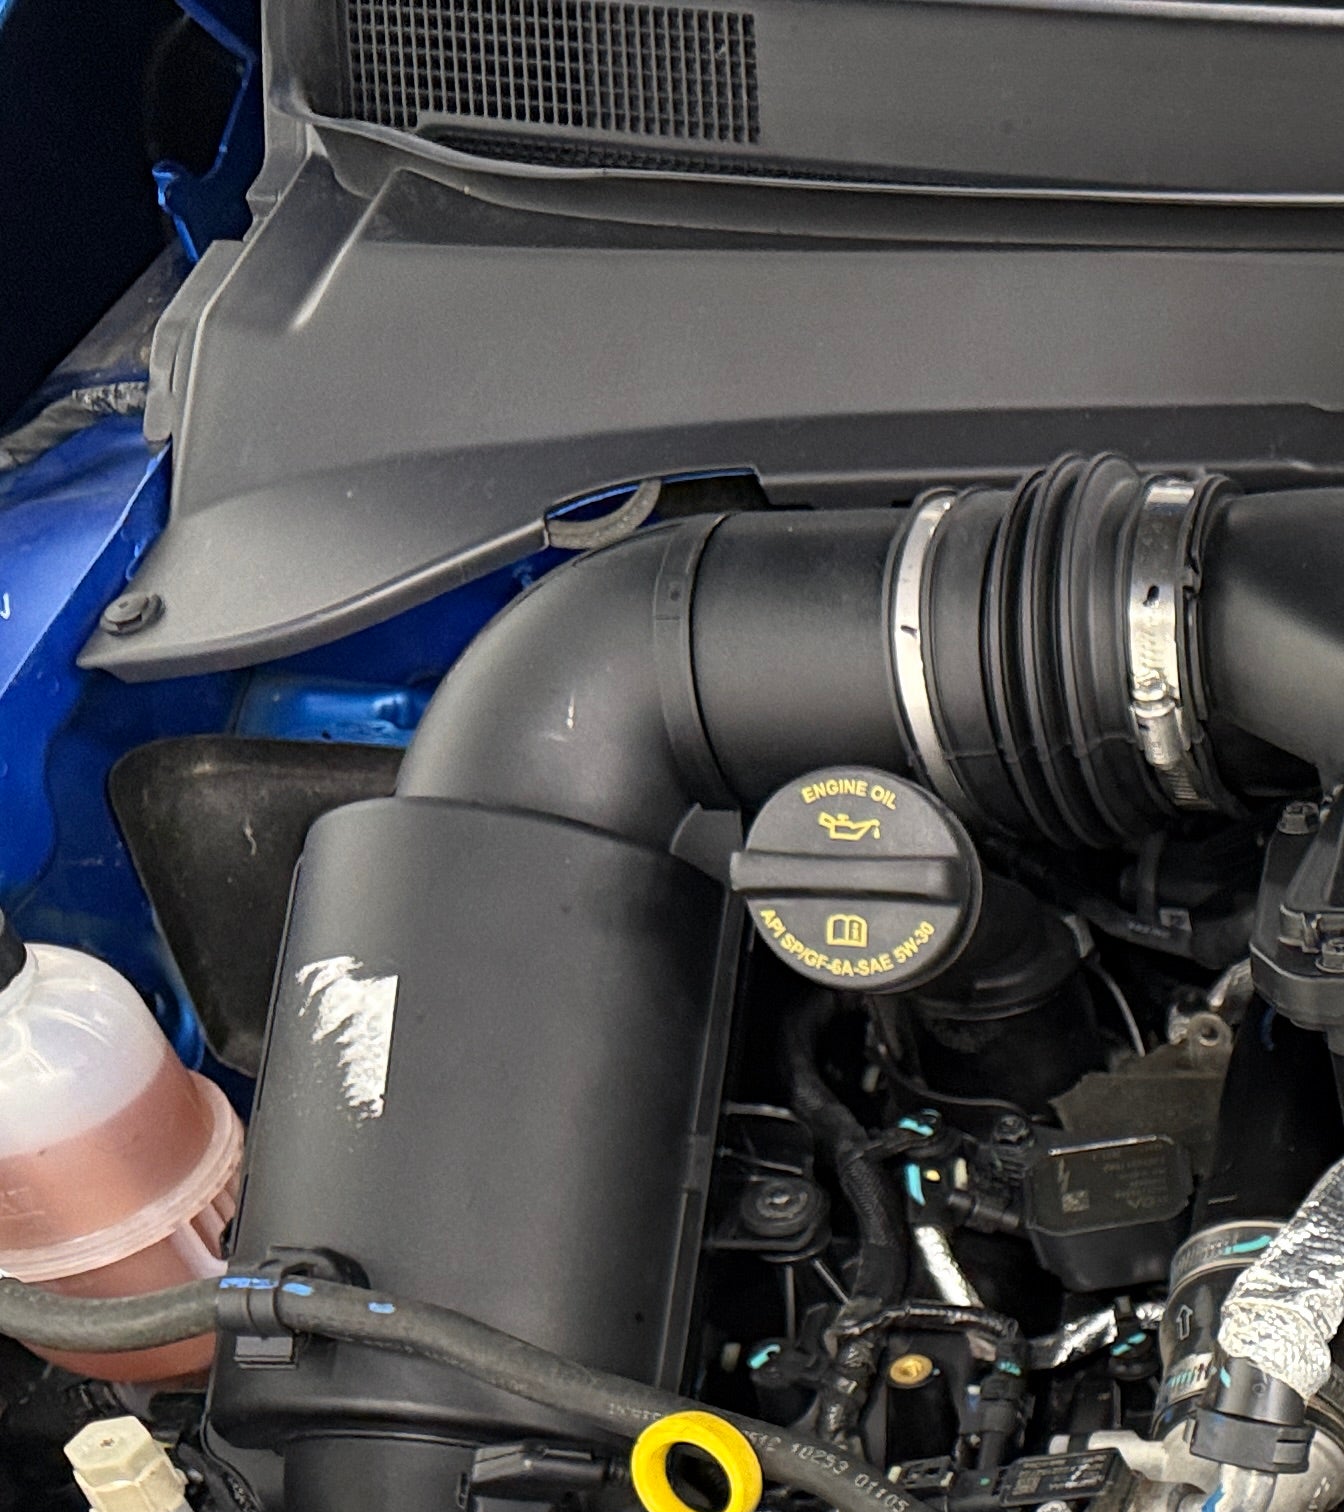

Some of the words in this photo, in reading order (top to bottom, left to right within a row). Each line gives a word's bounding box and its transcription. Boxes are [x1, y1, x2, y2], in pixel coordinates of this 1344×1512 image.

[801, 779, 868, 804] ENGINE
[870, 786, 897, 810] OIL
[760, 909, 783, 941] API
[895, 921, 936, 965] 5W-30
